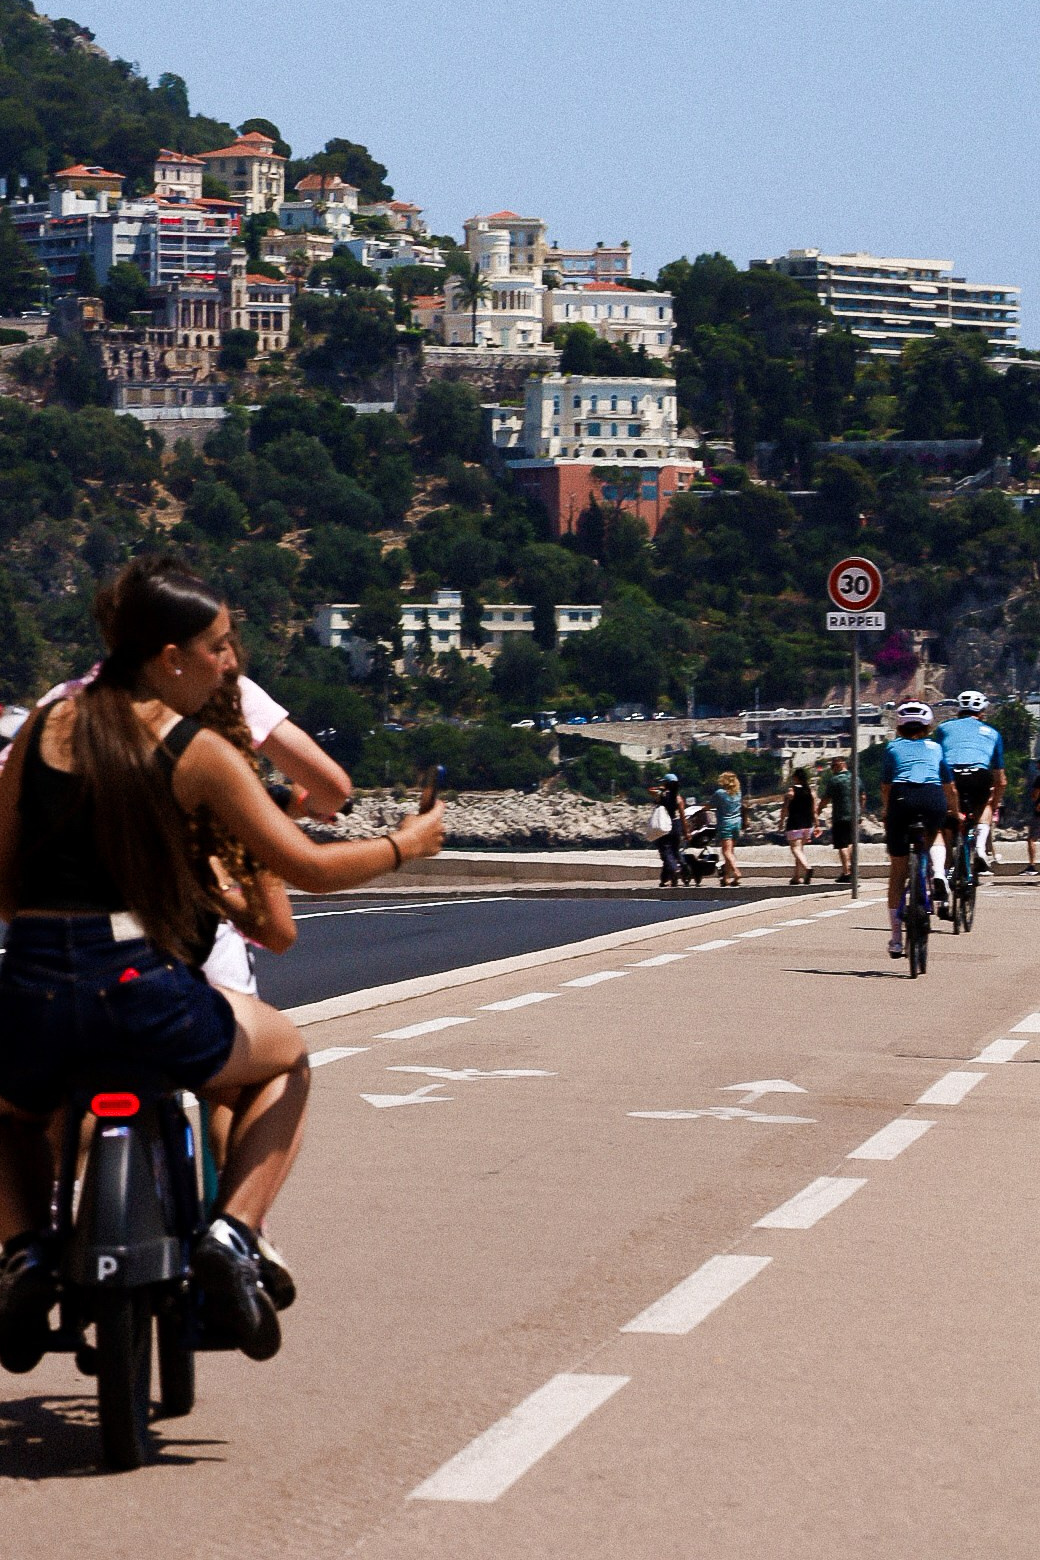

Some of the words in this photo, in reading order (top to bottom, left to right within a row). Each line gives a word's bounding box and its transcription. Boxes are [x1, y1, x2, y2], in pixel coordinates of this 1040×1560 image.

[840, 574, 869, 595] 30
[829, 616, 882, 627] RAPPEL
[98, 1255, 117, 1280] P
